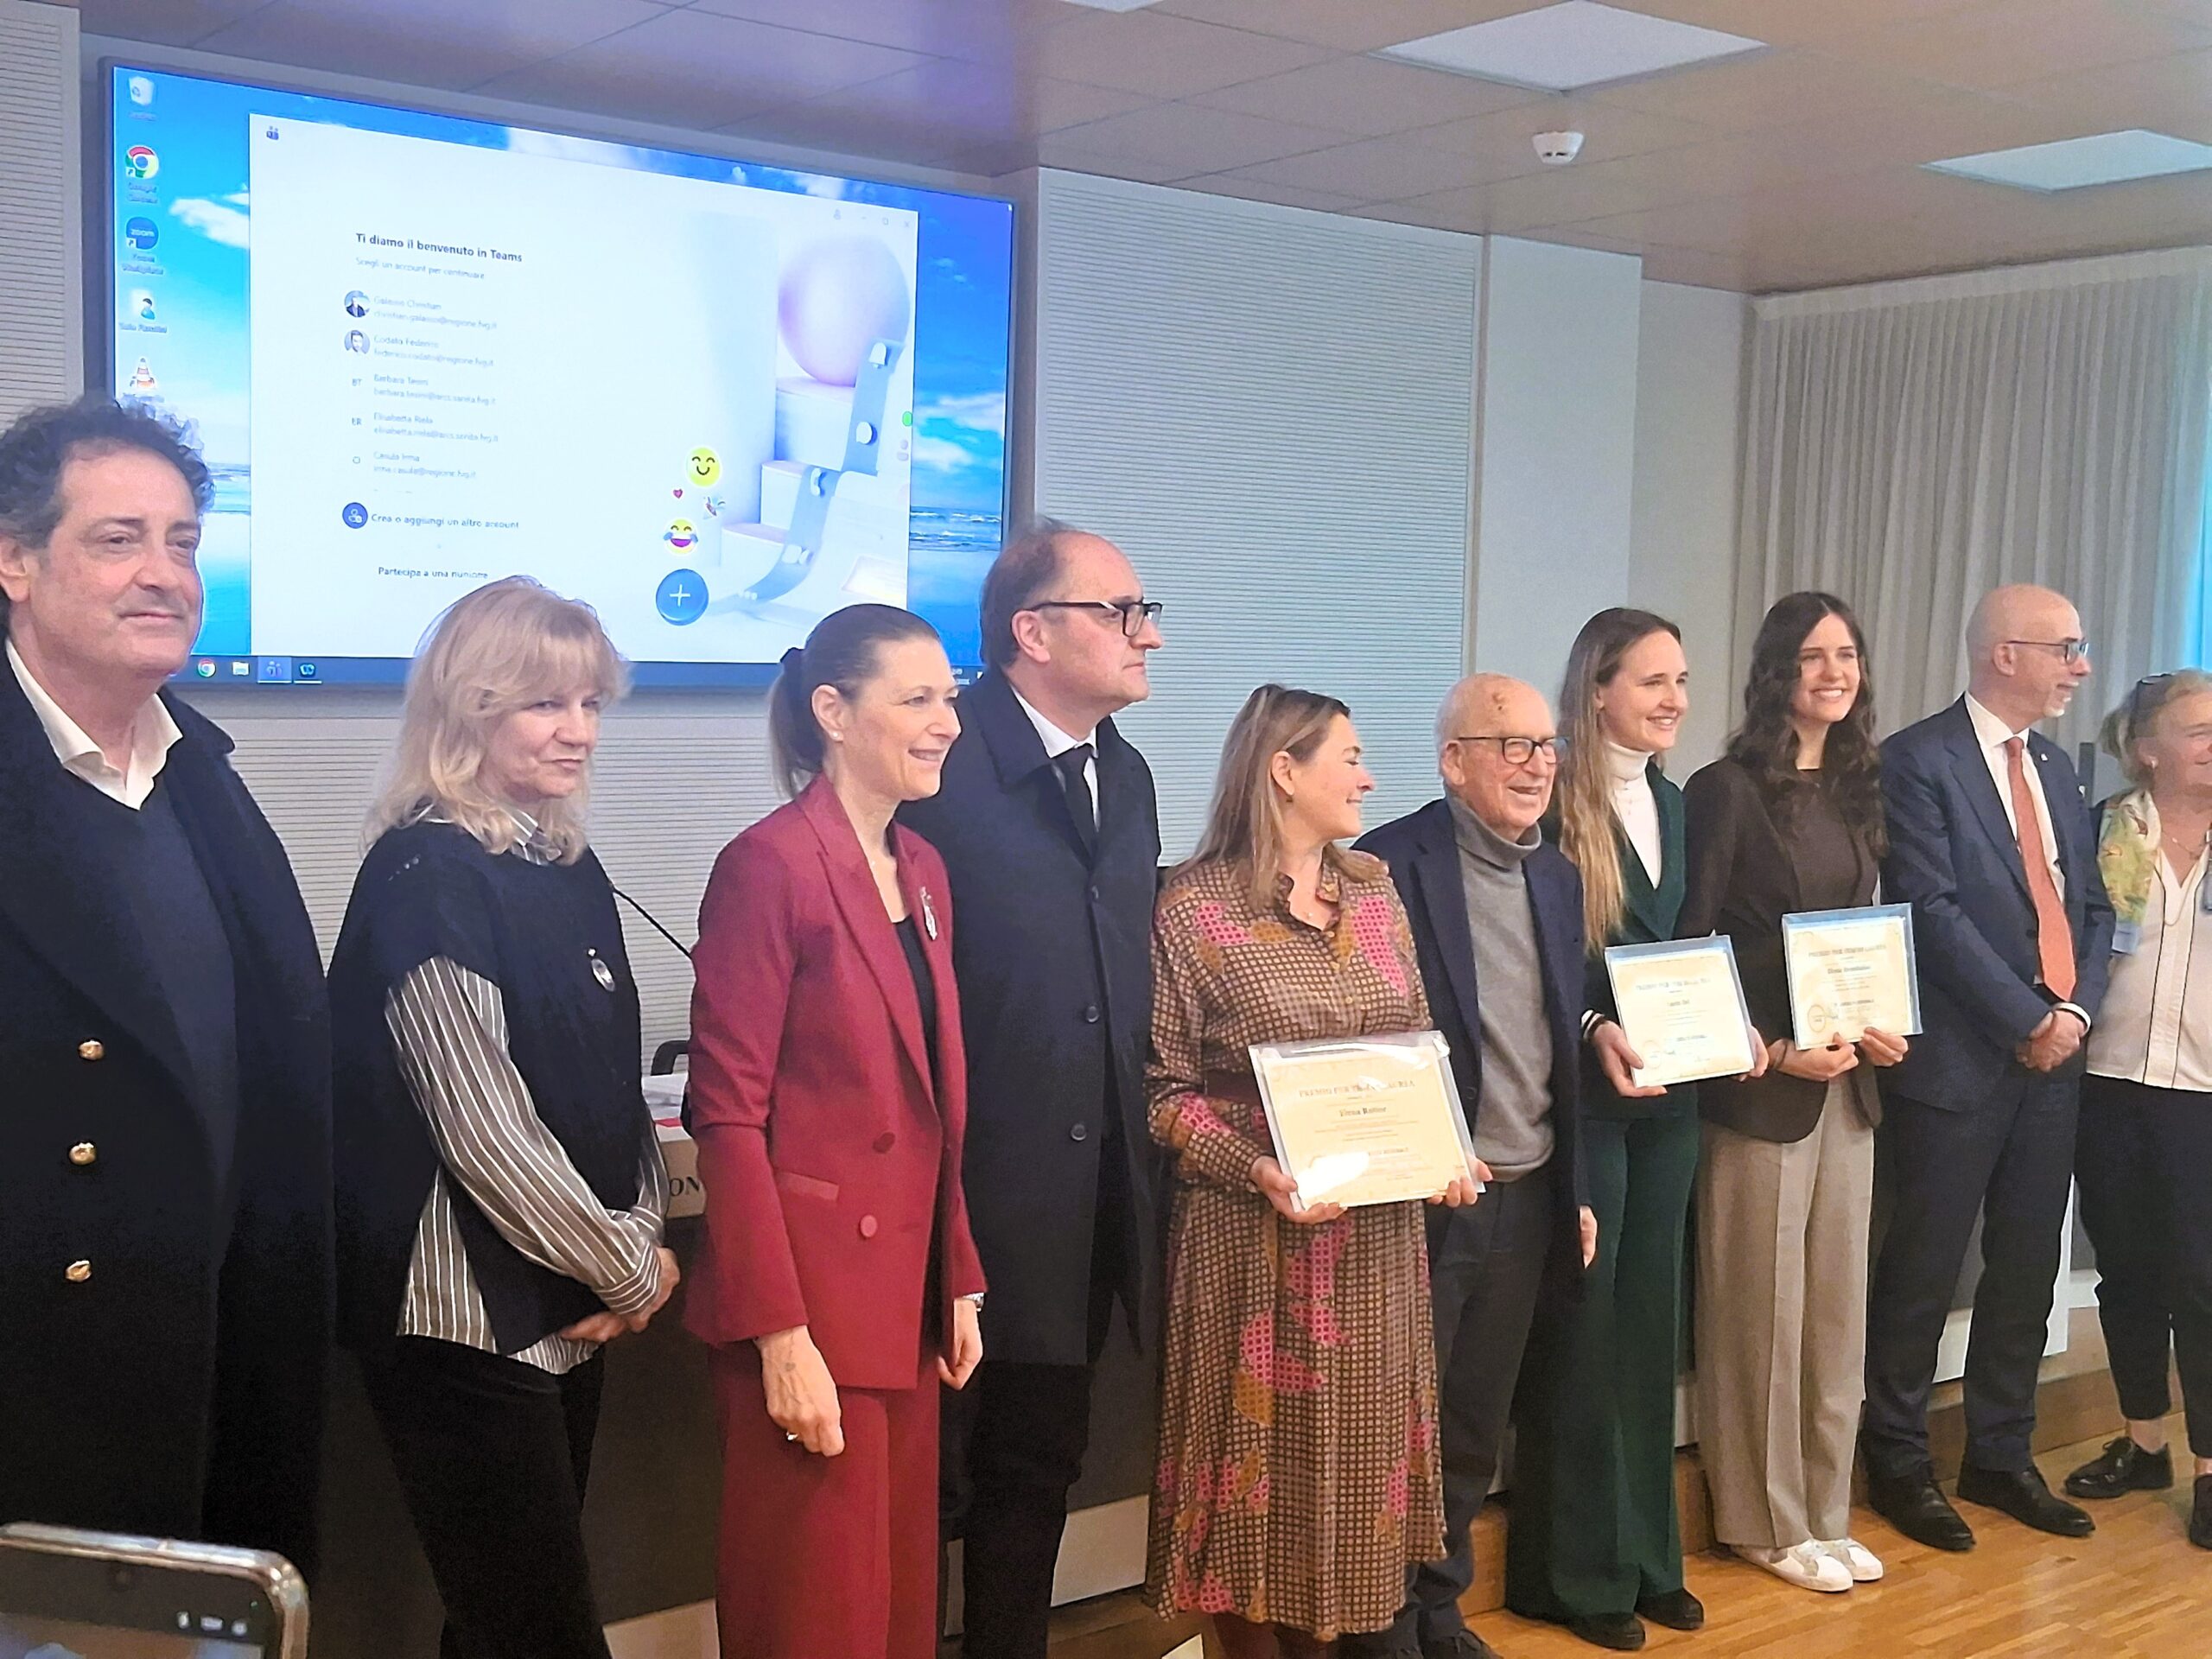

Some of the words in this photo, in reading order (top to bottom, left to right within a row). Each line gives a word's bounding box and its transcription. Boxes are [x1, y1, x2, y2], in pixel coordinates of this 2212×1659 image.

[356, 233, 365, 243] Ti
[369, 235, 404, 248] diamo
[407, 239, 414, 249] il
[417, 240, 474, 257] benvenuto
[477, 247, 486, 258] in
[490, 249, 523, 263] Teams
[395, 263, 426, 272] account
[429, 267, 442, 276] per
[371, 513, 392, 523] Crea
[404, 516, 444, 528] aggiungi
[461, 518, 482, 528] altro
[485, 520, 518, 530] account
[378, 567, 422, 580] Partecipa
